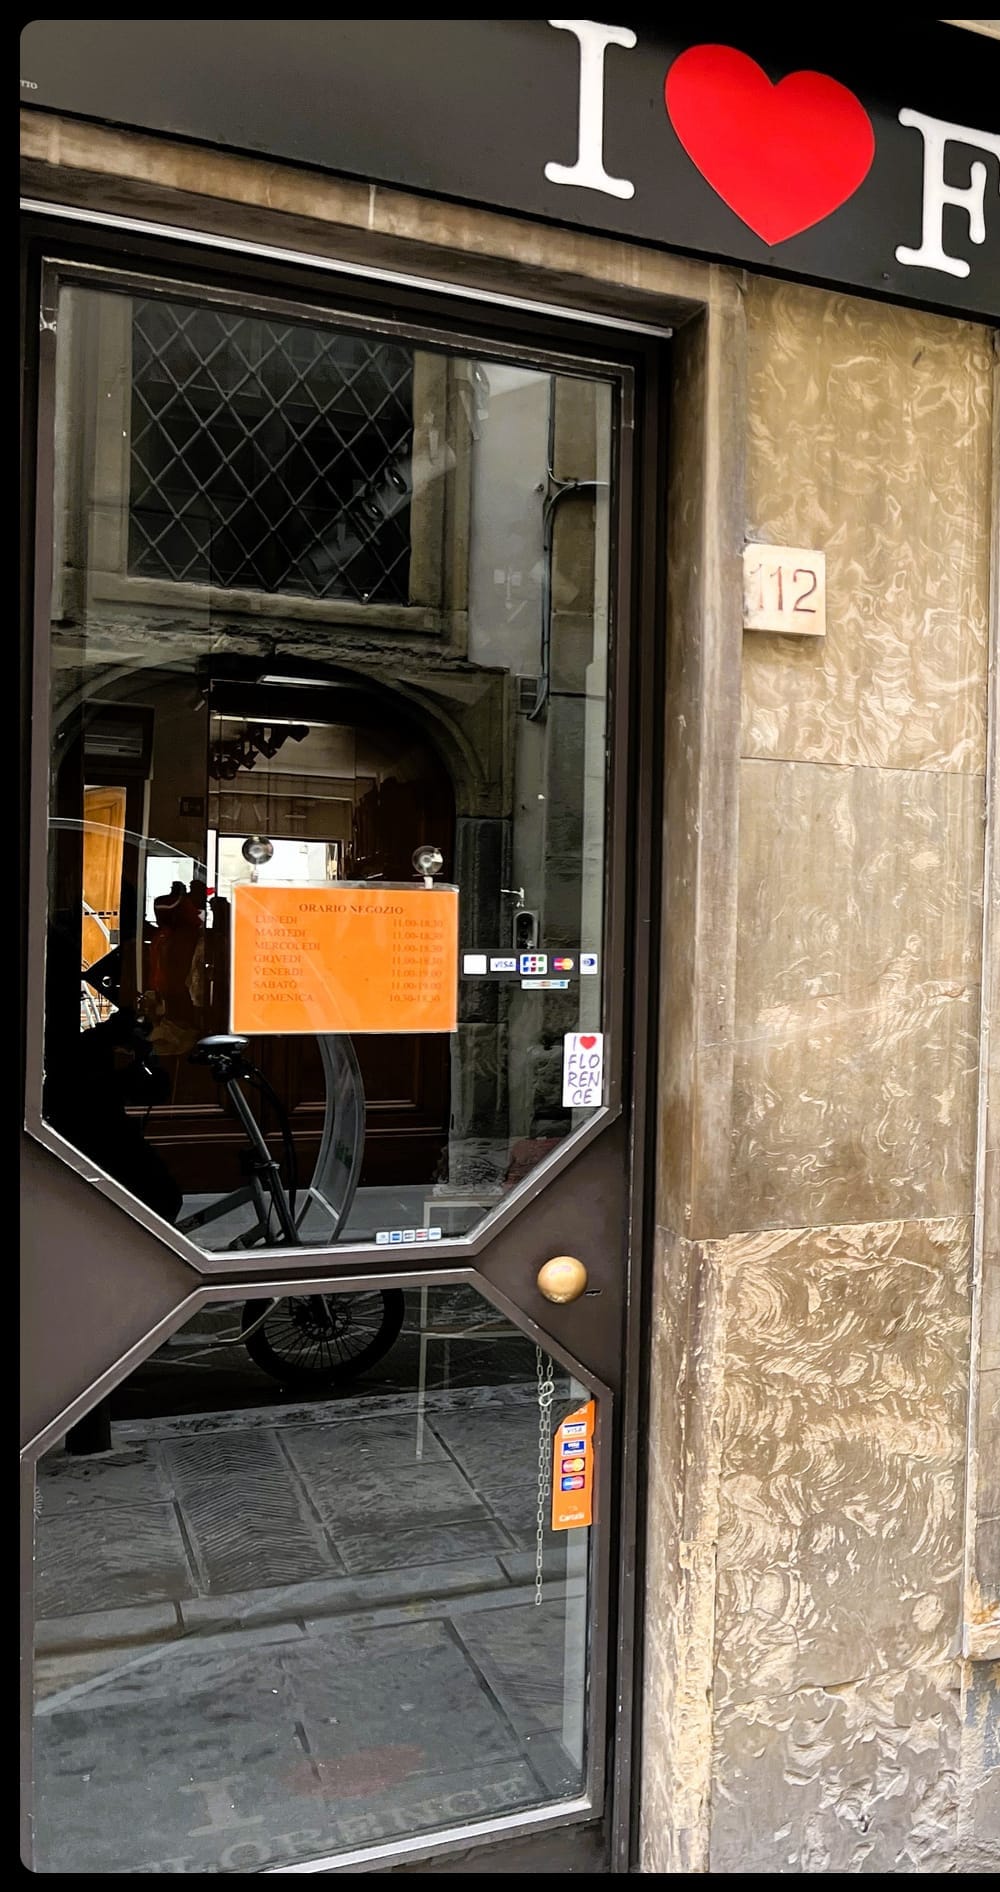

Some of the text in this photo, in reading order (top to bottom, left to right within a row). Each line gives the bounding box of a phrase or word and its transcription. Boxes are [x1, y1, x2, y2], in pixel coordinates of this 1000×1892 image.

[544, 19, 637, 200] I
[750, 563, 817, 613] 112
[298, 903, 405, 915] ORARIO NEGOZIO
[567, 1054, 601, 1070] FLO
[567, 1071, 601, 1089] REN
[572, 1089, 593, 1106] CE
